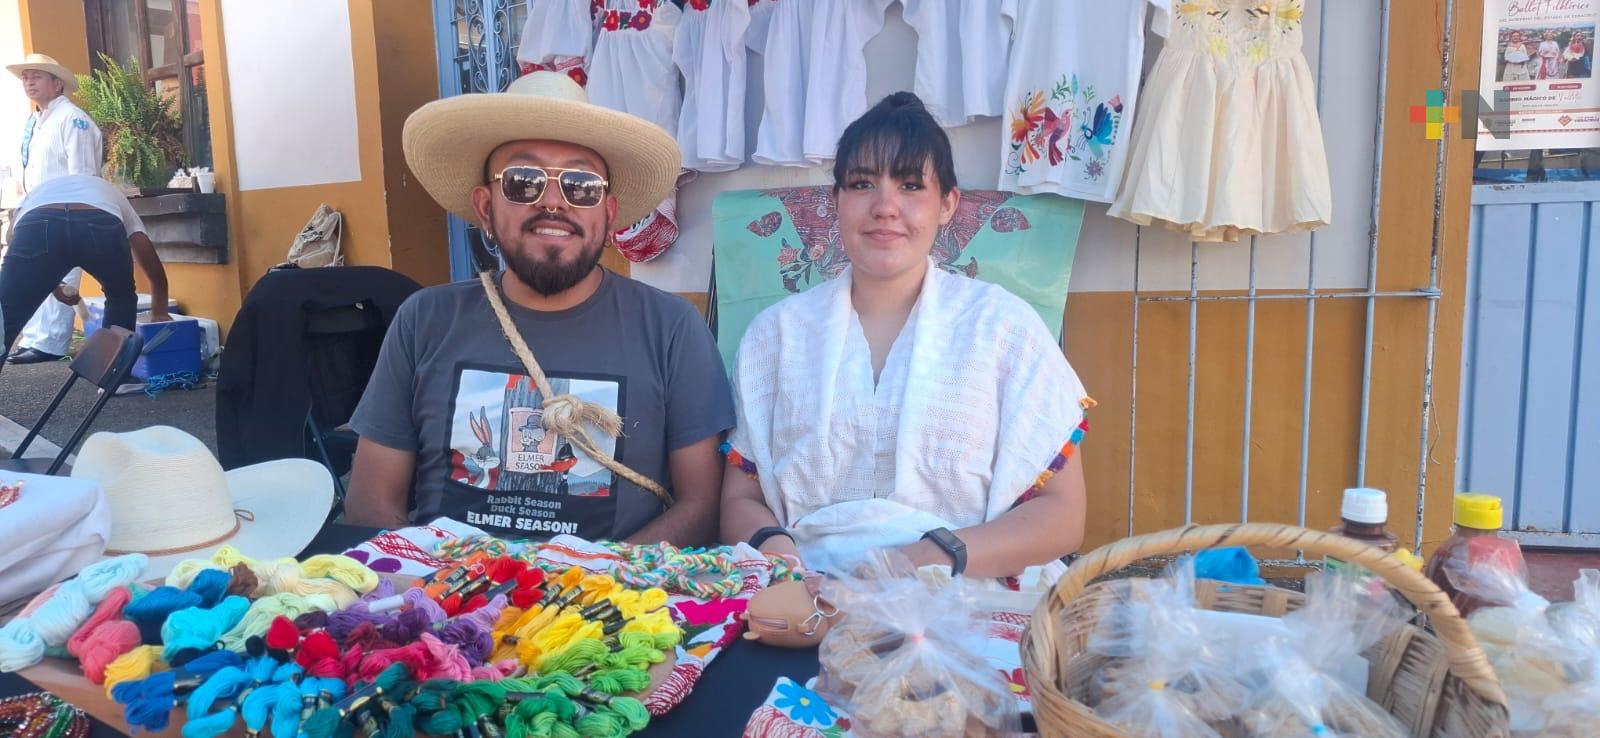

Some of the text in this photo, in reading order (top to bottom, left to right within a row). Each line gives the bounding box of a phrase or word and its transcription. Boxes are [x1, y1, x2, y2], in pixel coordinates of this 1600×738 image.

[517, 454, 545, 463] ELMER
[487, 495, 562, 510] Rabbit Season
[490, 504, 556, 519] Duck Season
[466, 511, 578, 534] ELMER SEASON!
